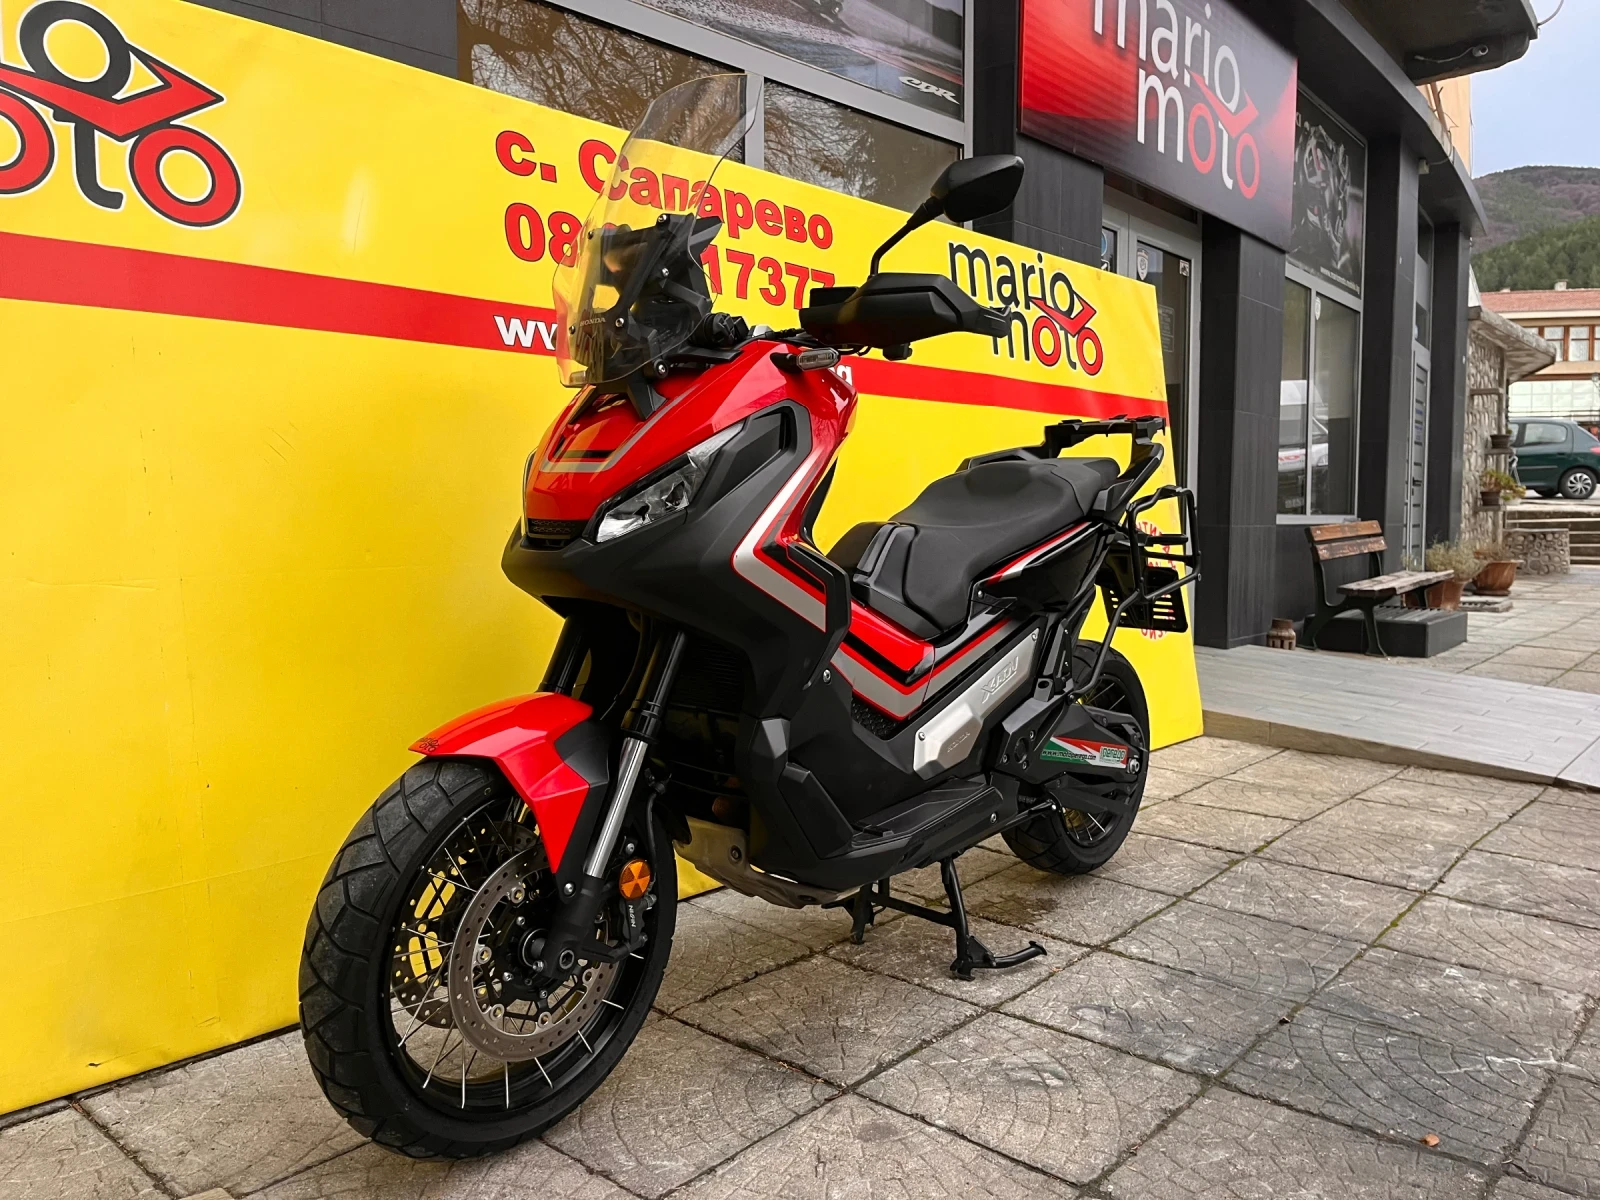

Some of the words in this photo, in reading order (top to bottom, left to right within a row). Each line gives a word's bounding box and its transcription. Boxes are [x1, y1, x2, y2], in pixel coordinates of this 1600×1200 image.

[898, 76, 960, 105] CBR
[1137, 68, 1260, 199] moto
[578, 139, 834, 250] Сапарево
[948, 242, 1075, 319] mario
[579, 316, 606, 328] HONDA
[989, 310, 1104, 377] moto
